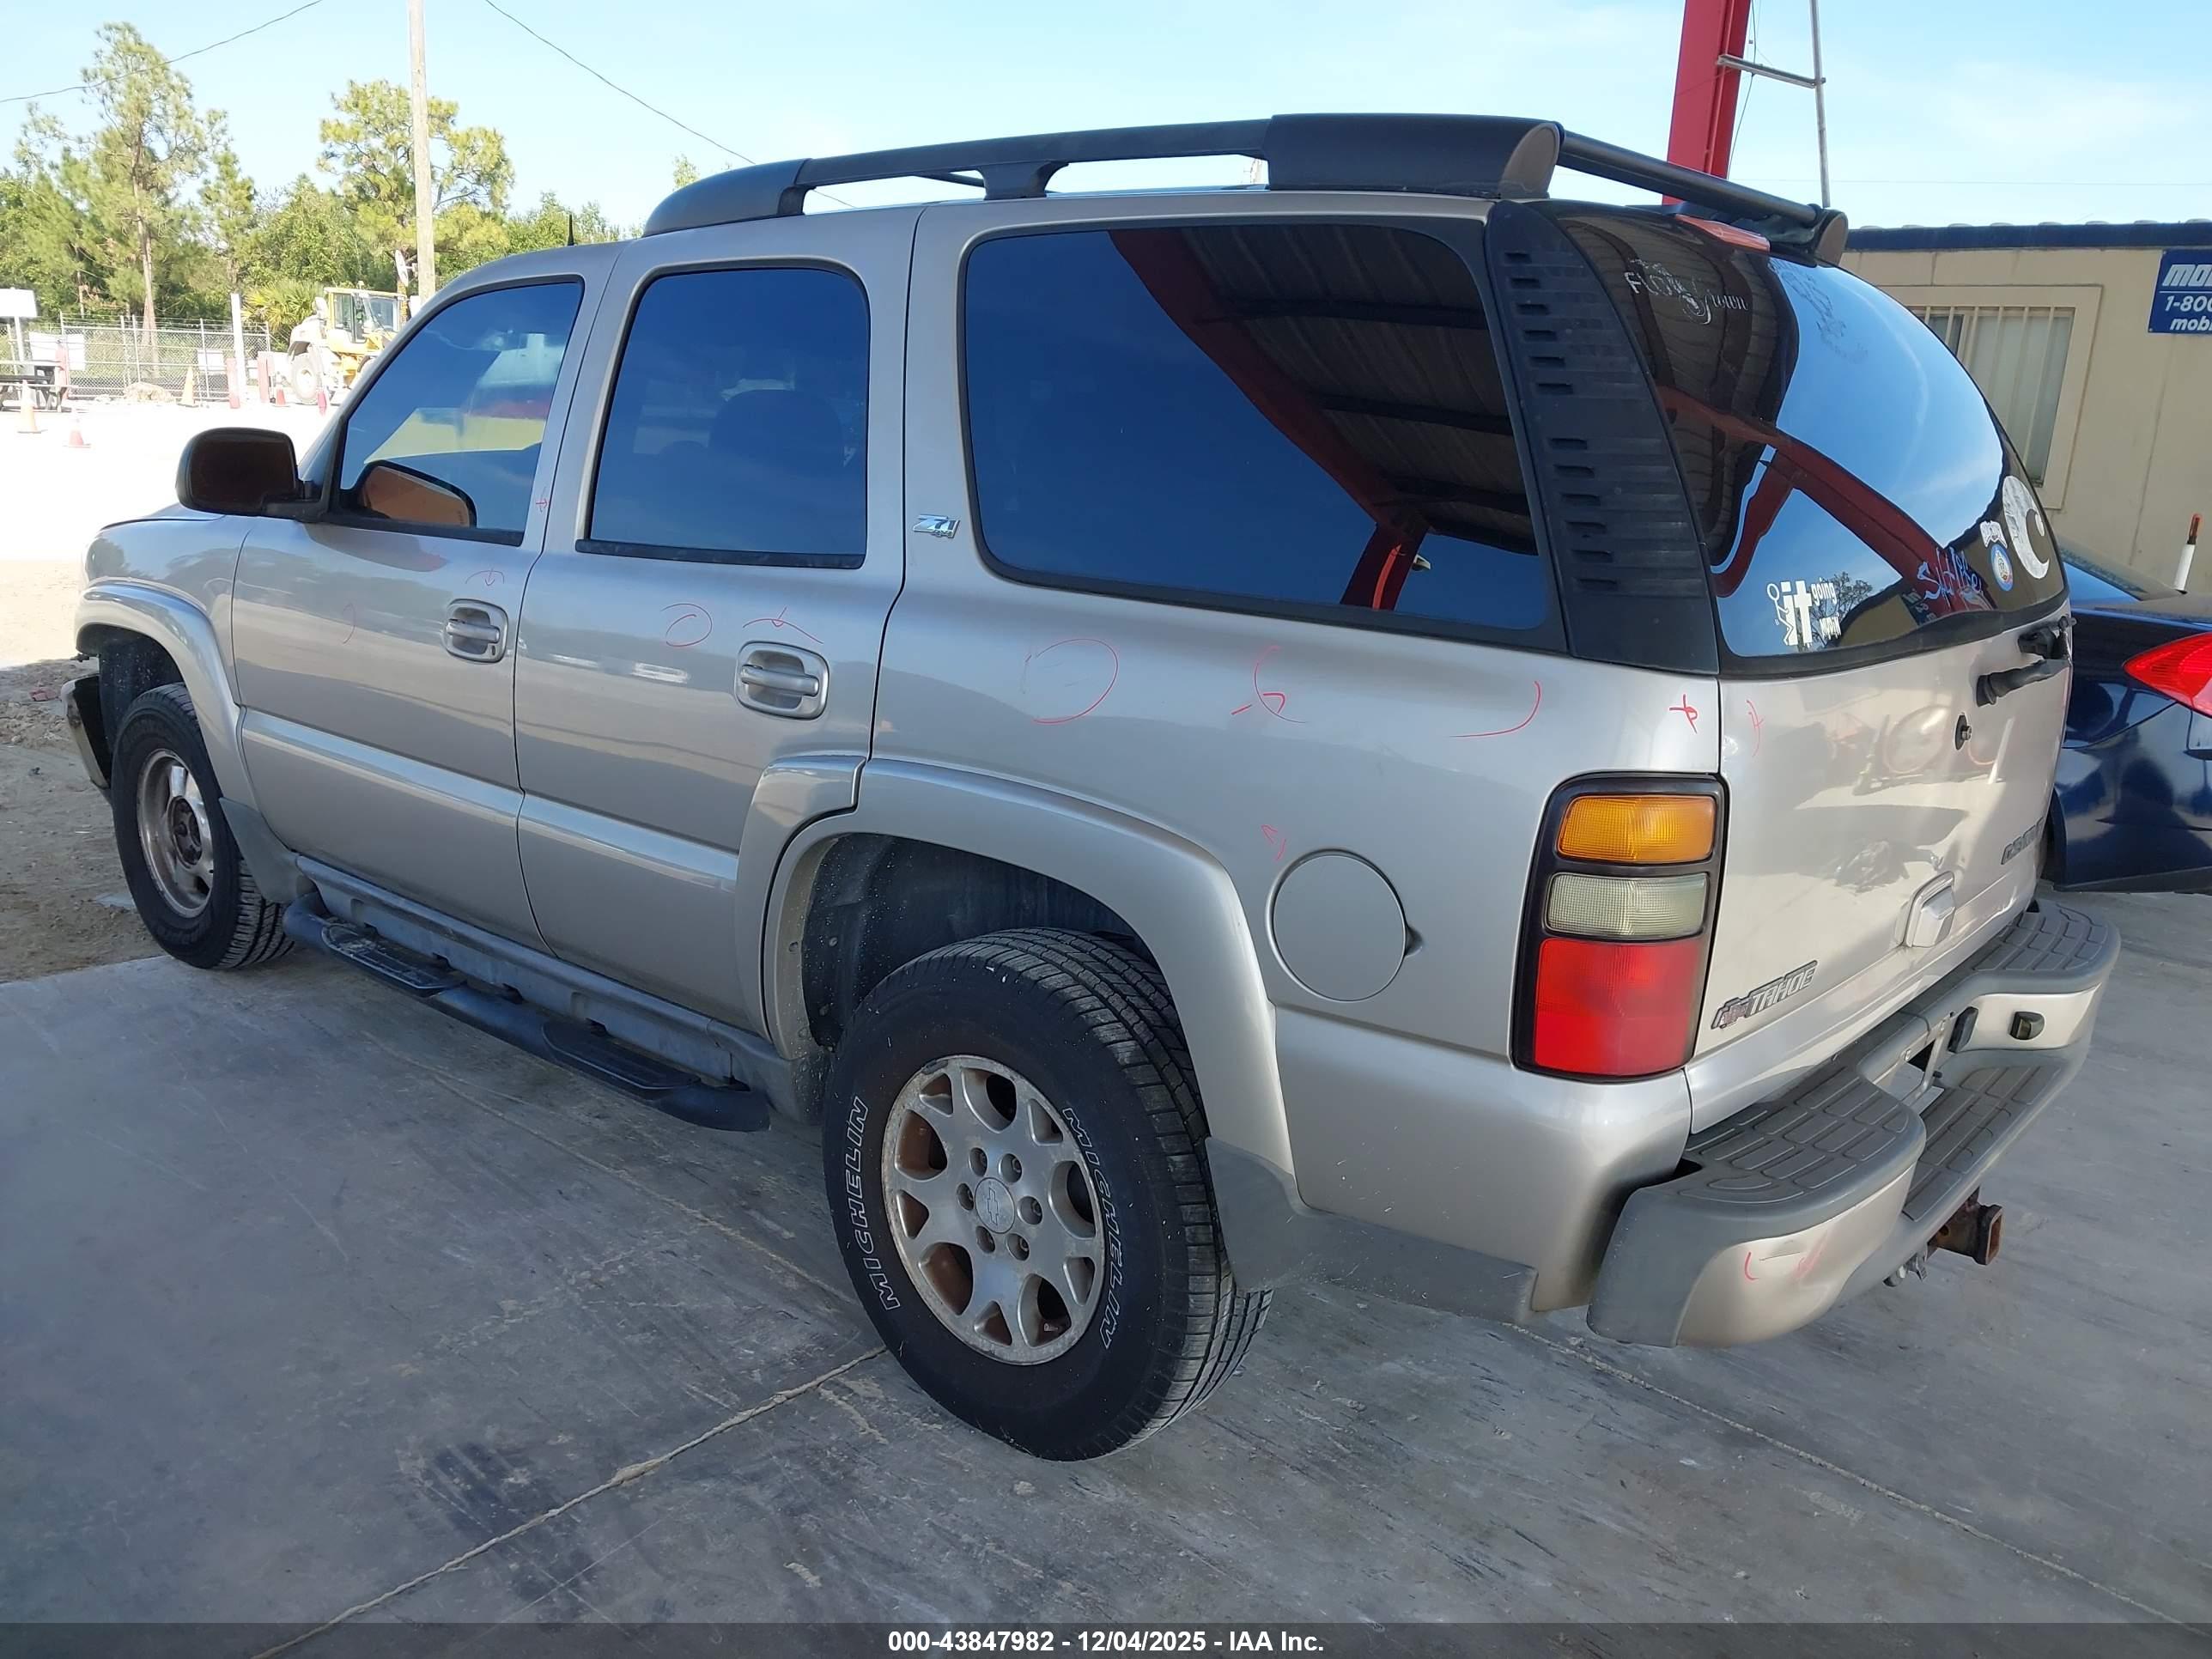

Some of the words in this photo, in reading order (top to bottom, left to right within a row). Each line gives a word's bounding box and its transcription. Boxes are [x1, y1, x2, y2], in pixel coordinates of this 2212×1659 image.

[1810, 577, 1838, 606] going
[1750, 966, 1818, 1017] TAHOE
[845, 1096, 901, 1311] MICHELIN
[1062, 1108, 1122, 1349] MICHELIN
